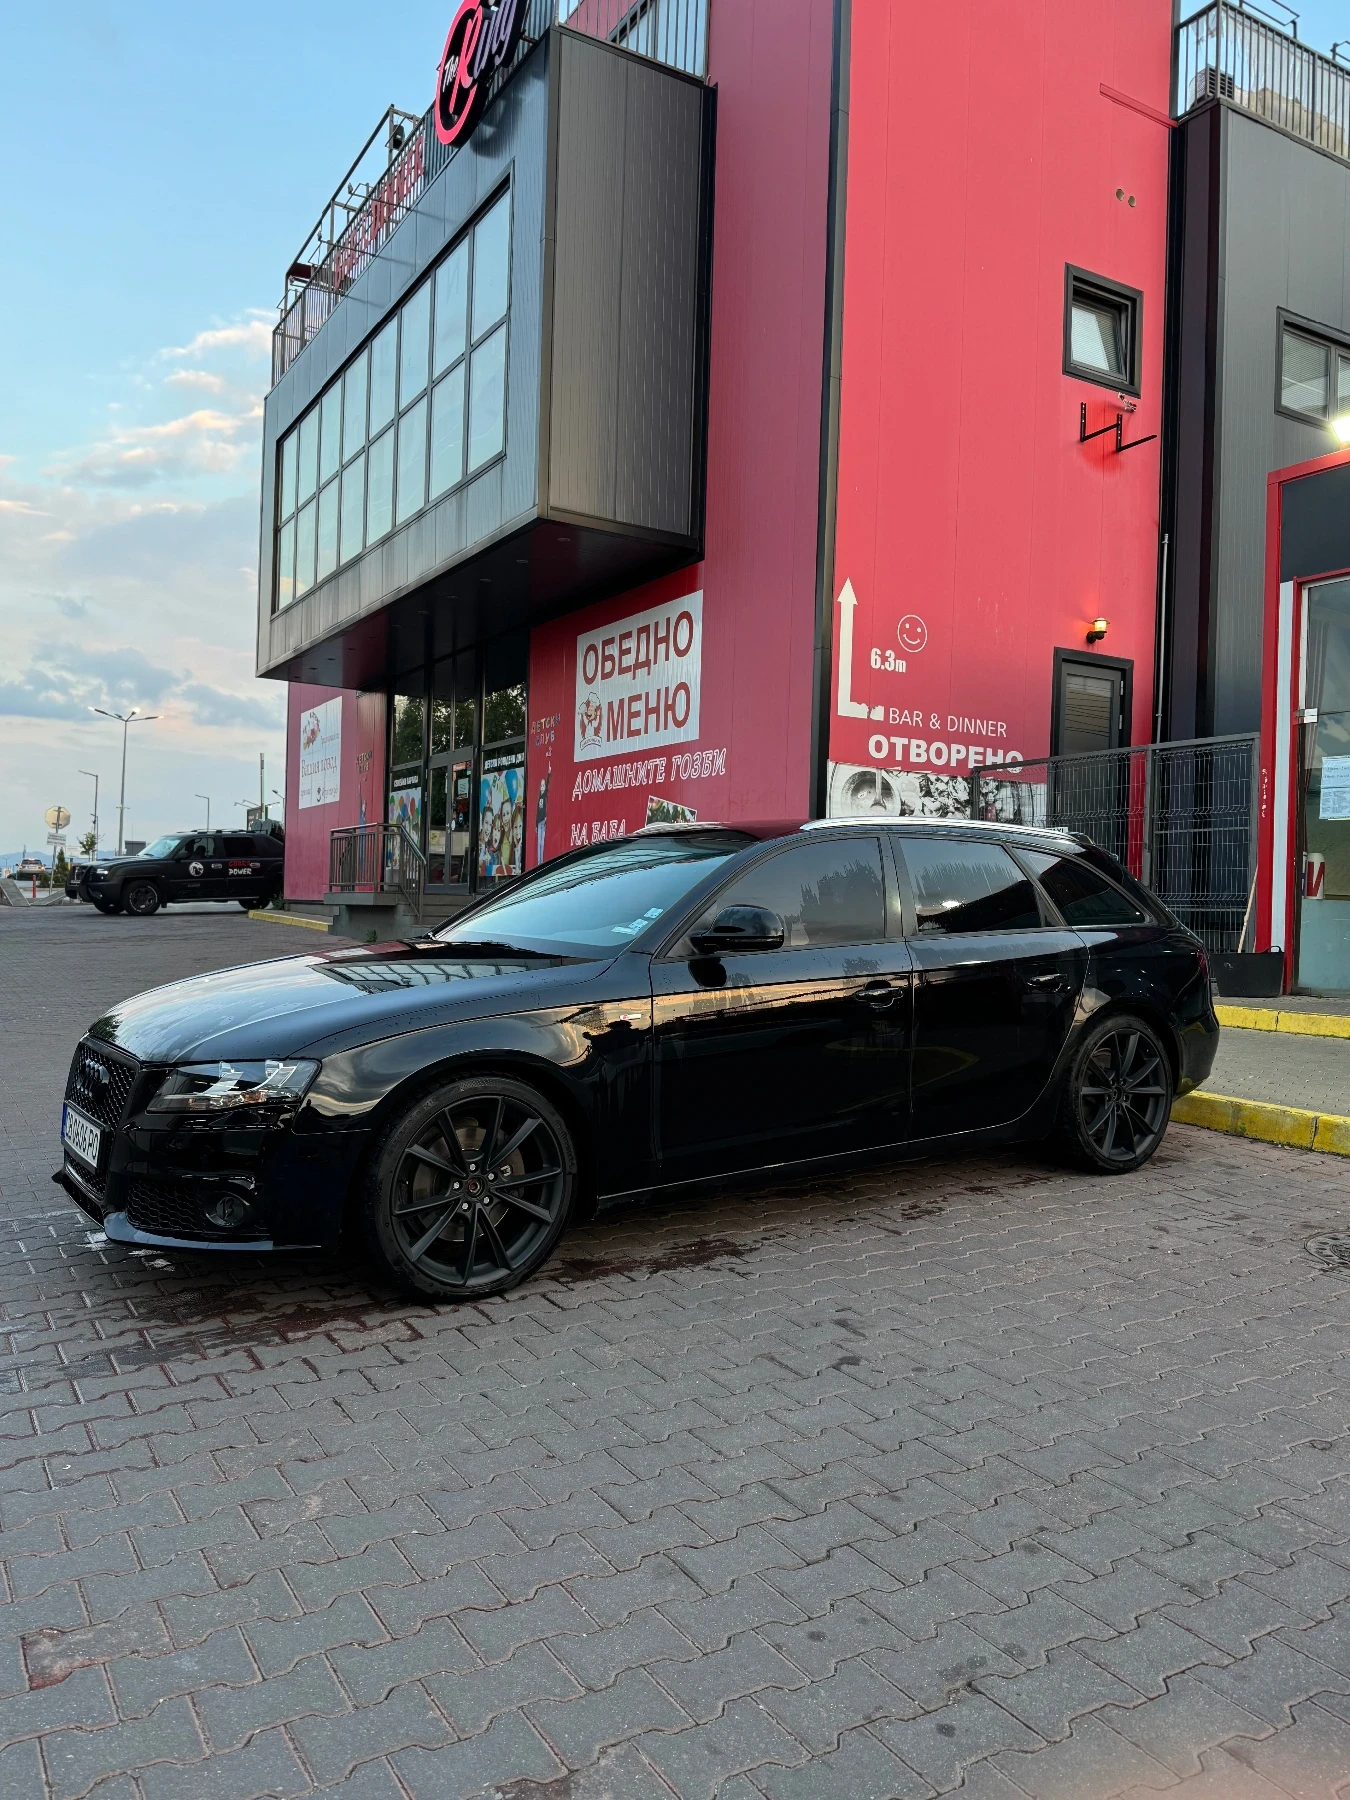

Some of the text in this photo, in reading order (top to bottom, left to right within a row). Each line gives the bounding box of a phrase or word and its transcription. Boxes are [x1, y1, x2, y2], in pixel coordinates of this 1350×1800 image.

[442, 54, 459, 93] The
[334, 228, 358, 289] BAR
[371, 136, 425, 241] DINNER
[583, 610, 694, 685] ОБЕДНО
[870, 647, 907, 673] 6.3m
[606, 681, 691, 743] МЕНЮ
[889, 707, 1007, 737] BAR & DINNER
[868, 734, 1023, 774] ОТВОРЕНО
[572, 748, 727, 802] ДОМАШНИТЕ ГОЗБИ
[570, 818, 627, 847] НА БАБА
[228, 867, 252, 876] POWER
